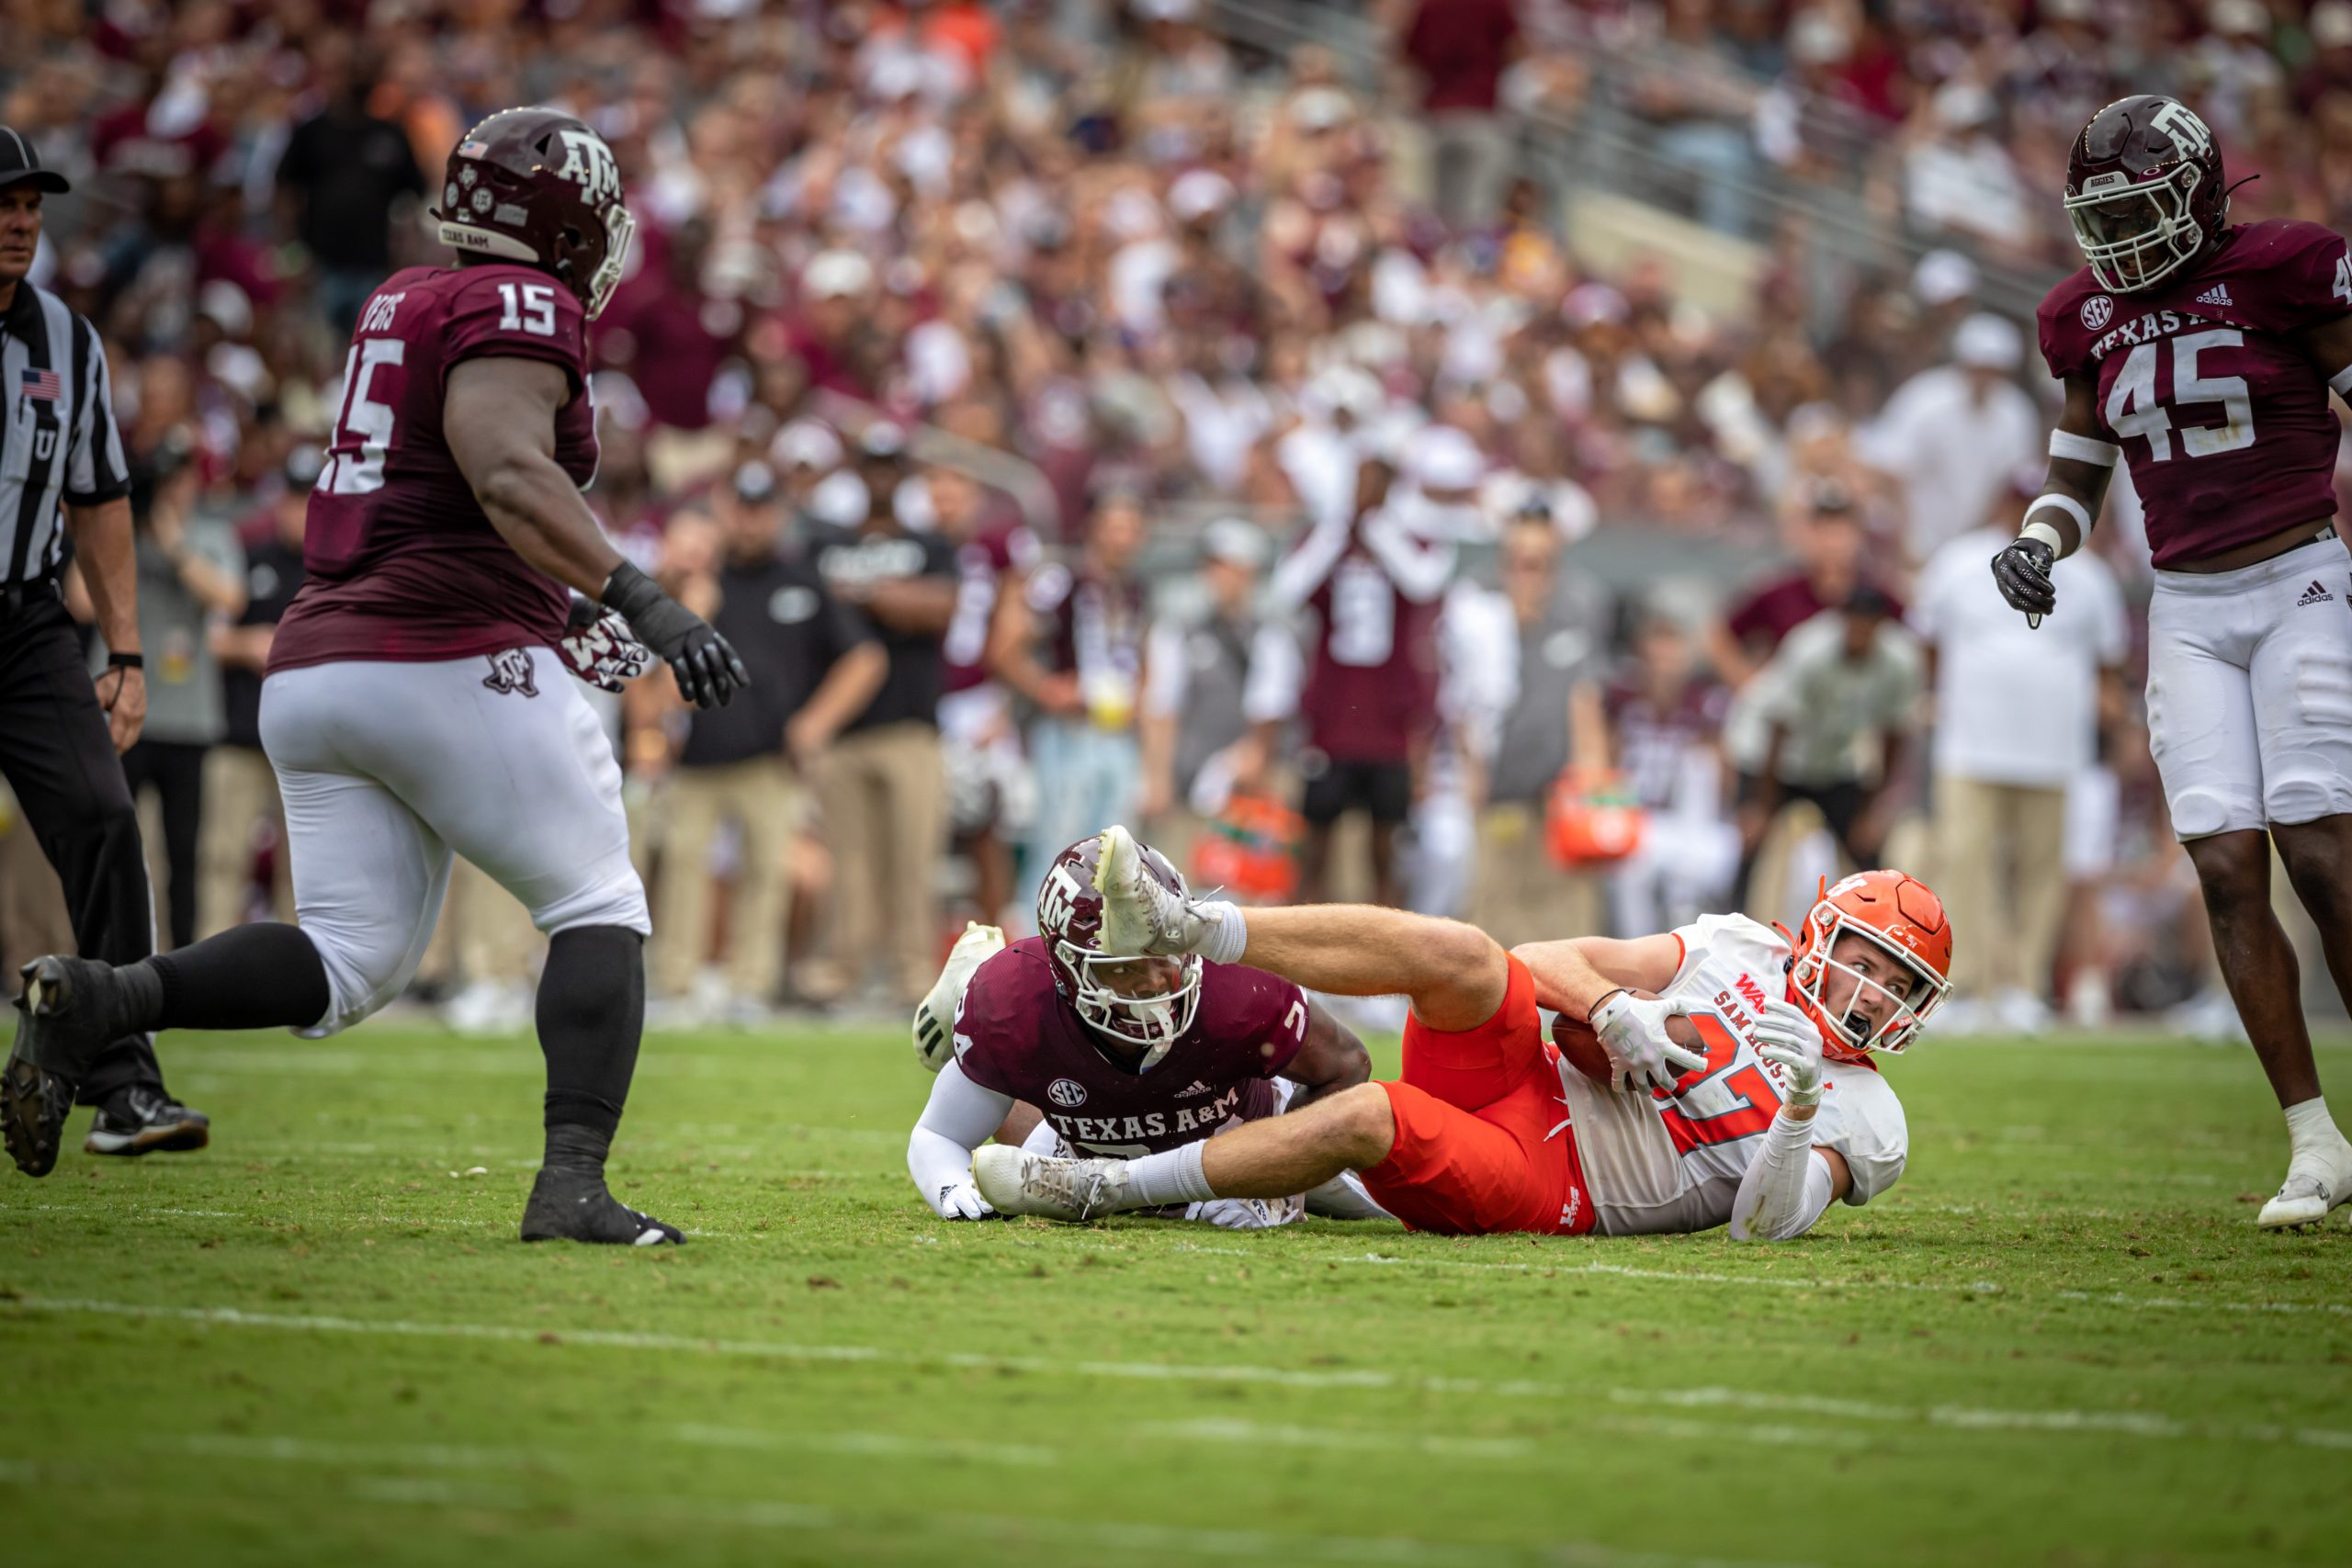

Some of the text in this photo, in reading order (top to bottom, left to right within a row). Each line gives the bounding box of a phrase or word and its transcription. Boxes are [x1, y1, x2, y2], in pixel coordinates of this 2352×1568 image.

[2090, 175, 2115, 187] AGGIES
[497, 282, 556, 336] 15
[2083, 297, 2111, 328] SEC
[2090, 310, 2181, 360] TEXAS
[316, 338, 406, 495] 15
[2105, 329, 2256, 462] 45
[35, 428, 56, 461] U
[2297, 593, 2334, 607] adidas
[1713, 990, 1752, 1032] SAM
[1050, 1081, 1084, 1105] SEC
[1174, 1086, 1212, 1098] adidas
[1651, 1011, 1784, 1158] 27
[1050, 1087, 1239, 1141] TEXAS A&M
